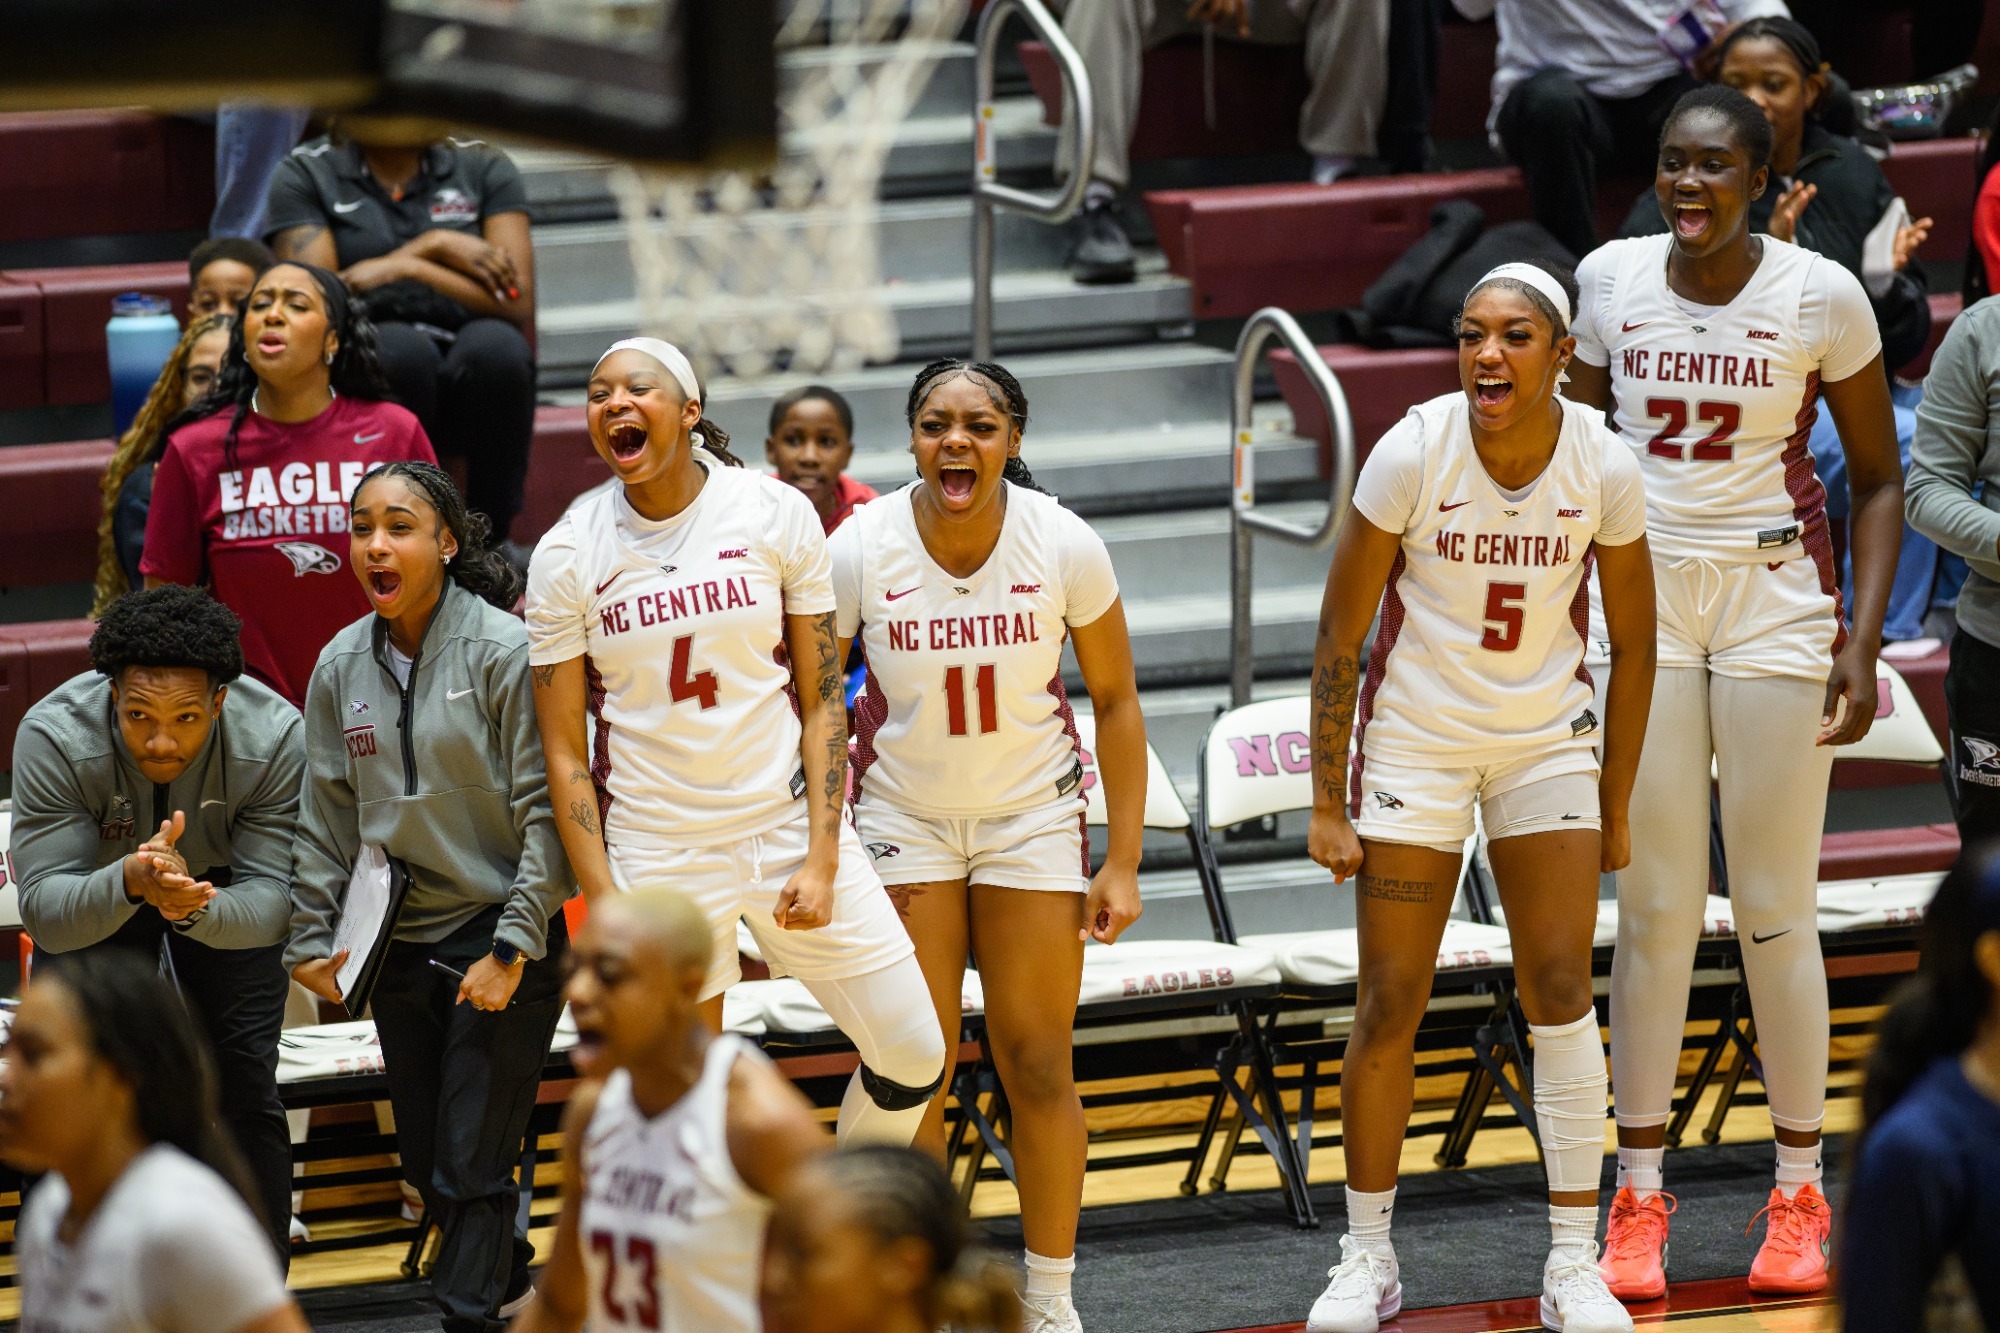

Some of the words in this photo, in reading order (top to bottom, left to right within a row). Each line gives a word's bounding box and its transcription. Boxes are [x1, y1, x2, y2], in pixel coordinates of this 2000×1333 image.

[1746, 330, 1779, 341] MEAC
[1623, 349, 1649, 379] NC
[1657, 351, 1774, 388] CENTRAL
[1644, 395, 1743, 463] 22
[219, 461, 384, 513] EAGLE
[223, 505, 352, 540] BASKETB
[1557, 508, 1582, 519] MEAC
[718, 548, 748, 560] MEAC
[1436, 530, 1465, 562] NC
[1474, 533, 1571, 567] CENTRAL
[600, 601, 630, 637] NC
[637, 576, 757, 627] CENTRAL
[1010, 584, 1041, 594] MEAC
[888, 620, 919, 651] NC
[930, 612, 1040, 650] CENTRAL
[1478, 580, 1528, 653] 5
[667, 632, 721, 712] 4
[941, 662, 1000, 738] 11
[1227, 731, 1313, 777] NC
[1438, 950, 1492, 972] LES
[1122, 966, 1235, 998] EAGLES
[589, 1229, 661, 1333] 23
